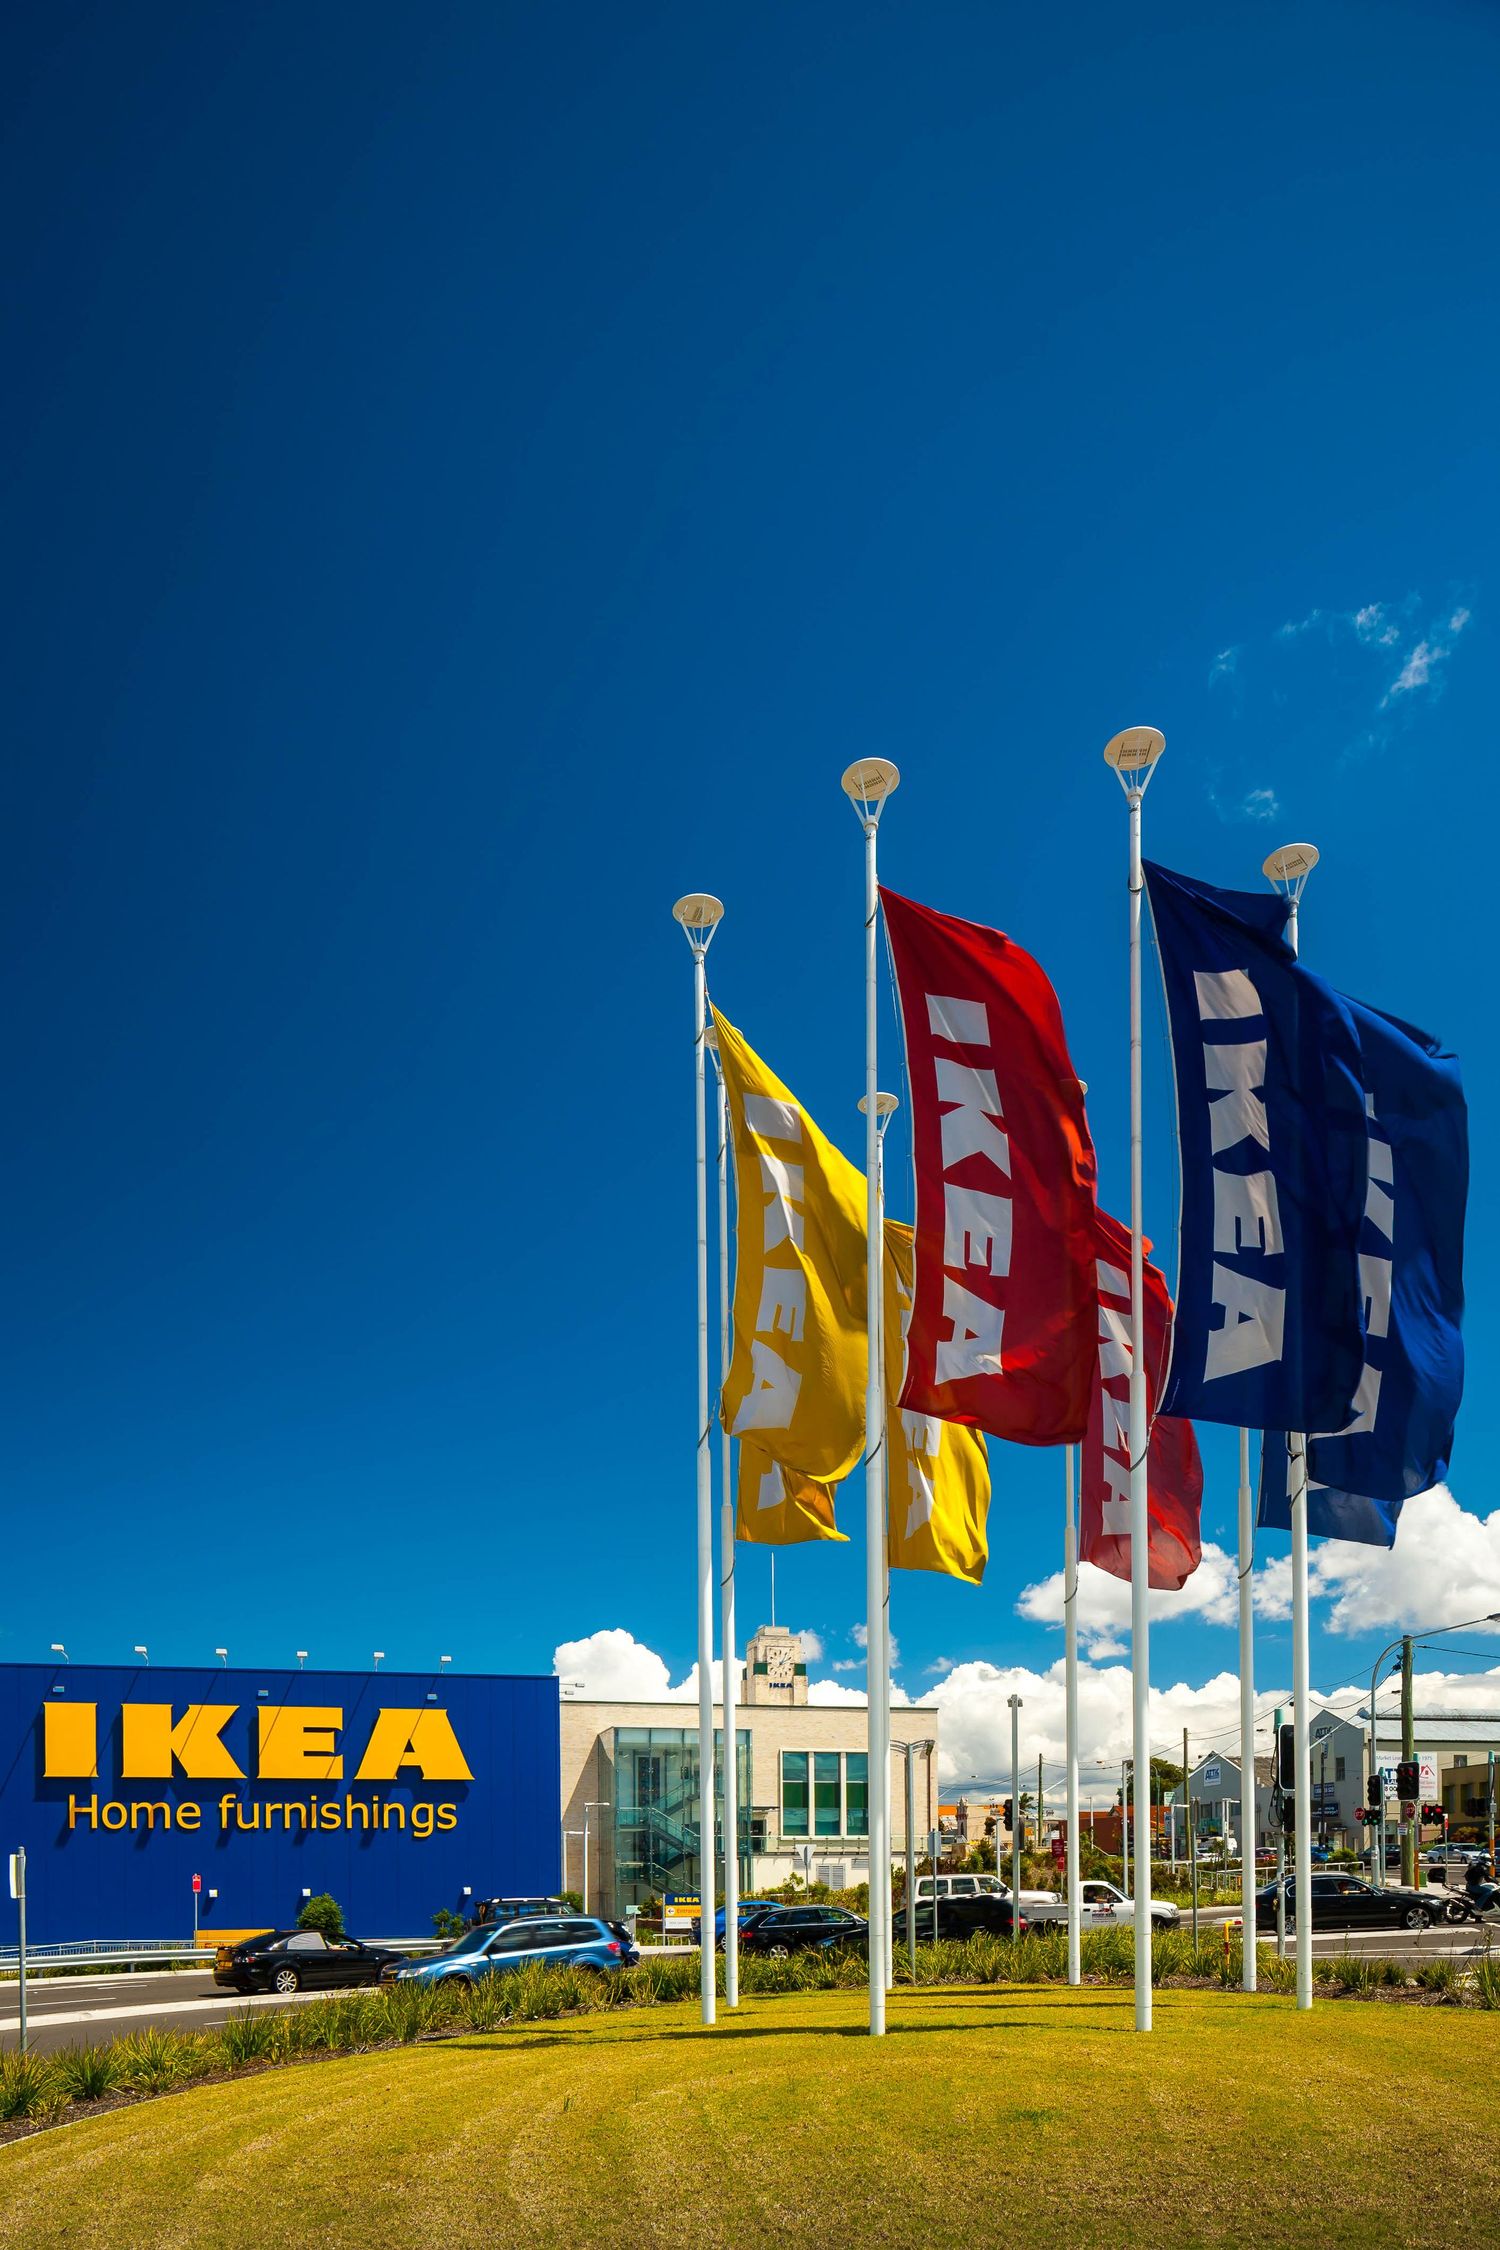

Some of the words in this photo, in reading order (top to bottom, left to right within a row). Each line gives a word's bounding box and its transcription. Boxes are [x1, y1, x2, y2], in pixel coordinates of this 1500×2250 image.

[731, 1091, 806, 1436] IKEA
[925, 993, 1014, 1386] IKEA
[1193, 969, 1287, 1382] IKEA
[43, 1701, 475, 1781] IKEA
[68, 1794, 202, 1830] Home
[218, 1794, 458, 1838] furnishings
